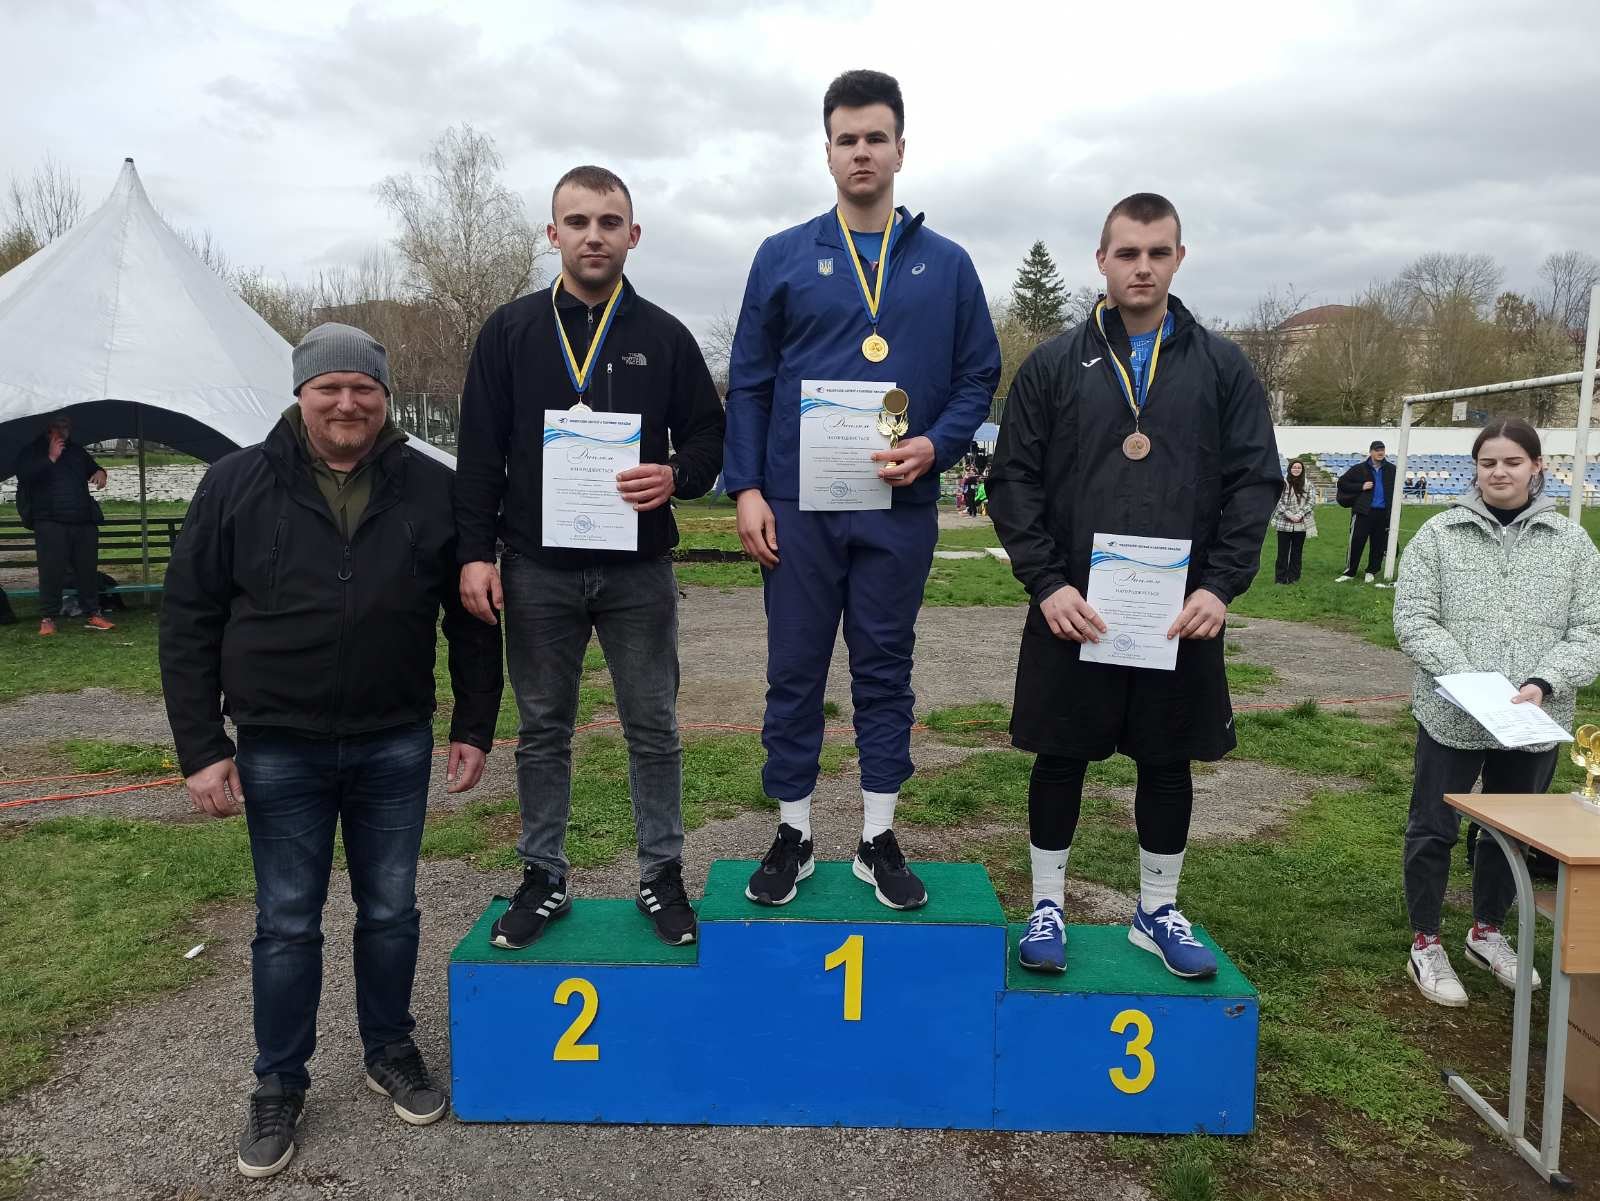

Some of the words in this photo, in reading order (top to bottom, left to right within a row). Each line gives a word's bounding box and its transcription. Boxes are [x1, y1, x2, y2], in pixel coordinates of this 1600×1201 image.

[553, 978, 599, 1060] 2
[826, 936, 863, 1020] 1
[1109, 1010, 1155, 1094] 3
